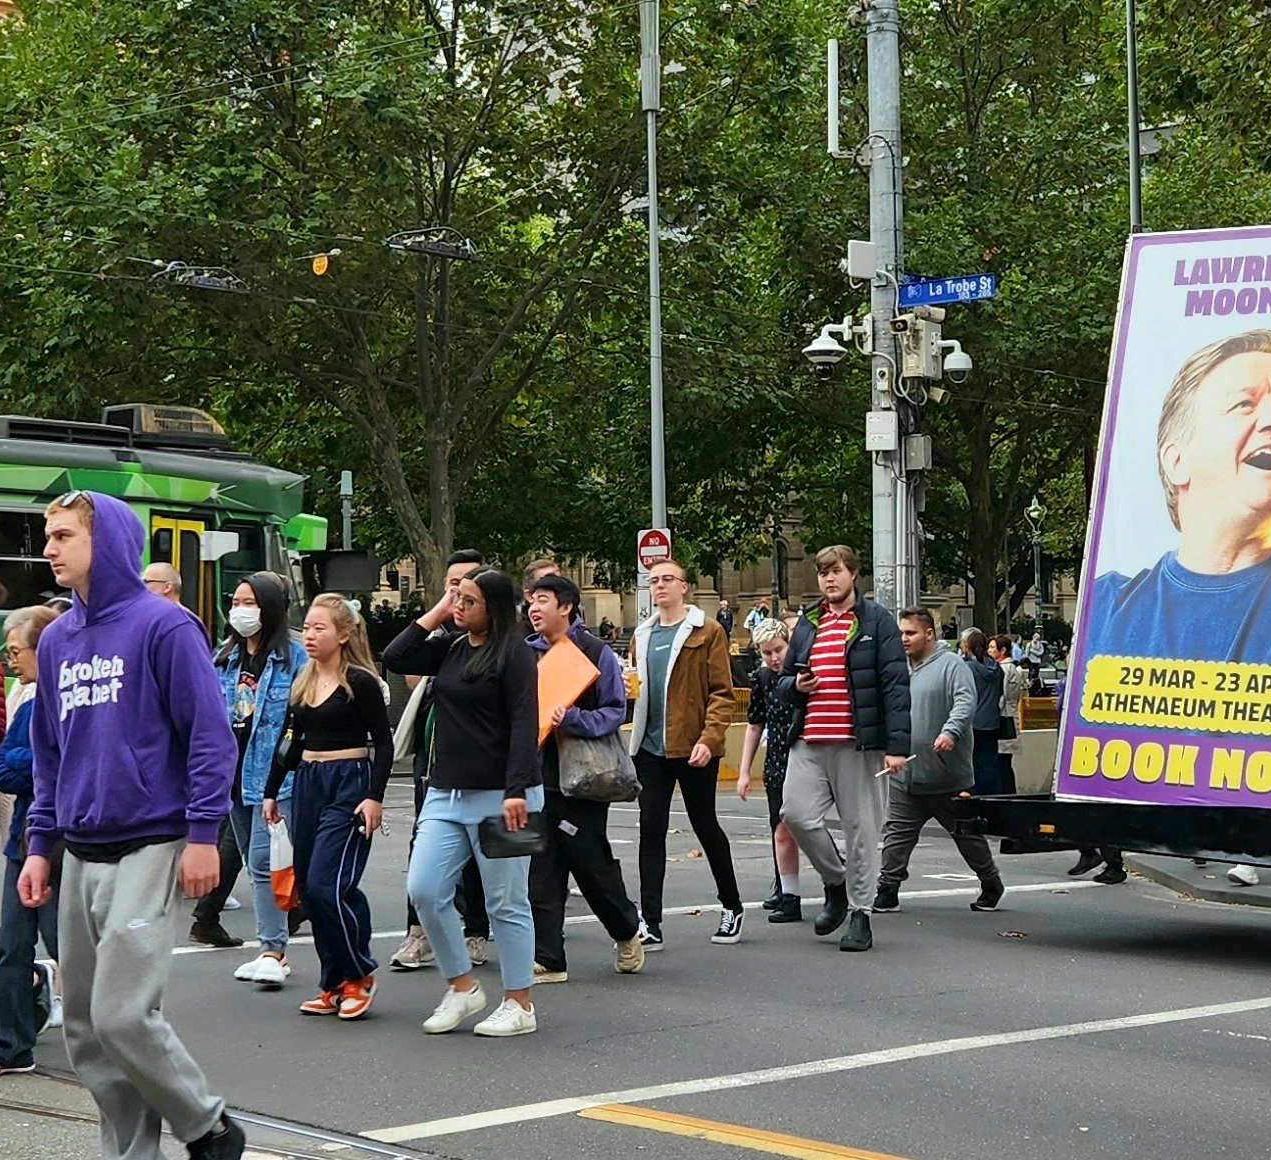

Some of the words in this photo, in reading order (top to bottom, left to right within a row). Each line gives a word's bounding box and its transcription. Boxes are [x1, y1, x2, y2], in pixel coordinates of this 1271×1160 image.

[929, 283, 943, 296] La
[945, 278, 977, 294] Trobe
[979, 275, 992, 290] St
[649, 537, 660, 545] NO
[58, 654, 124, 690] broken
[1119, 667, 1144, 686] 29
[1149, 668, 1196, 689] MAR
[1214, 672, 1241, 692] 23
[60, 677, 123, 722] planet
[1090, 692, 1216, 718] ATHENAEUM
[1069, 736, 1200, 786] BOOK
